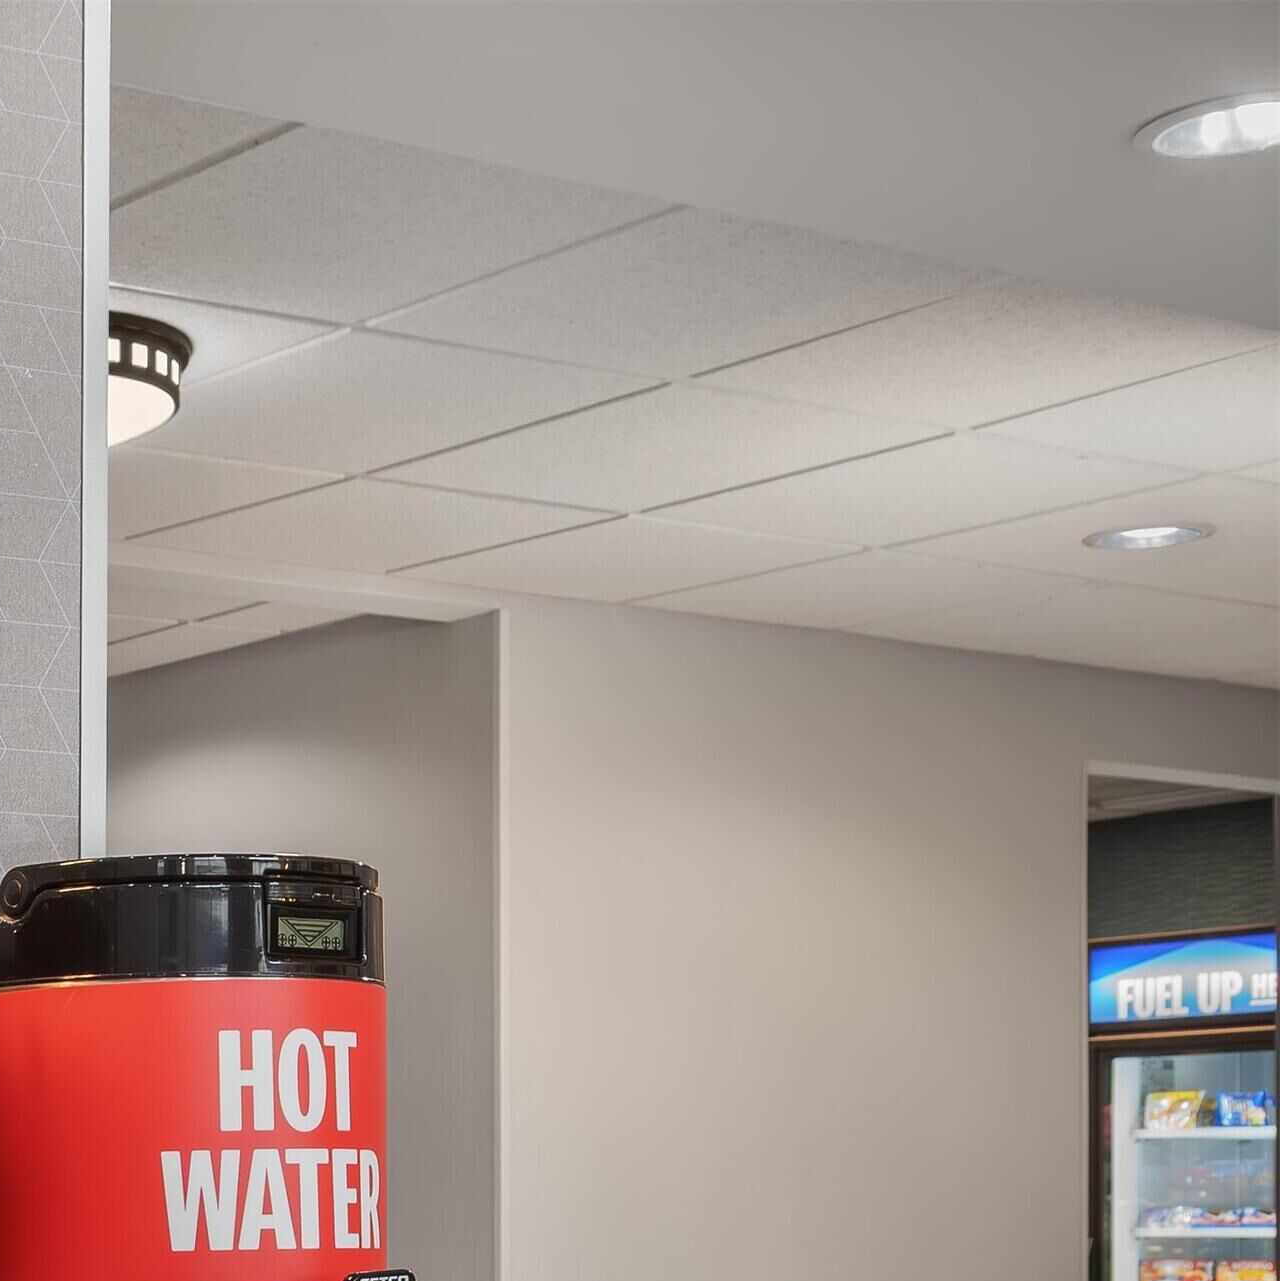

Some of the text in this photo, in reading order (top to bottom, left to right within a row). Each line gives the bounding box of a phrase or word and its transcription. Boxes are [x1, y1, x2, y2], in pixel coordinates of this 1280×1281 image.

[1117, 974, 1189, 1020] FUEL
[1197, 971, 1243, 1015] UP
[218, 1027, 358, 1134] HOT
[160, 1148, 383, 1253] WATER
